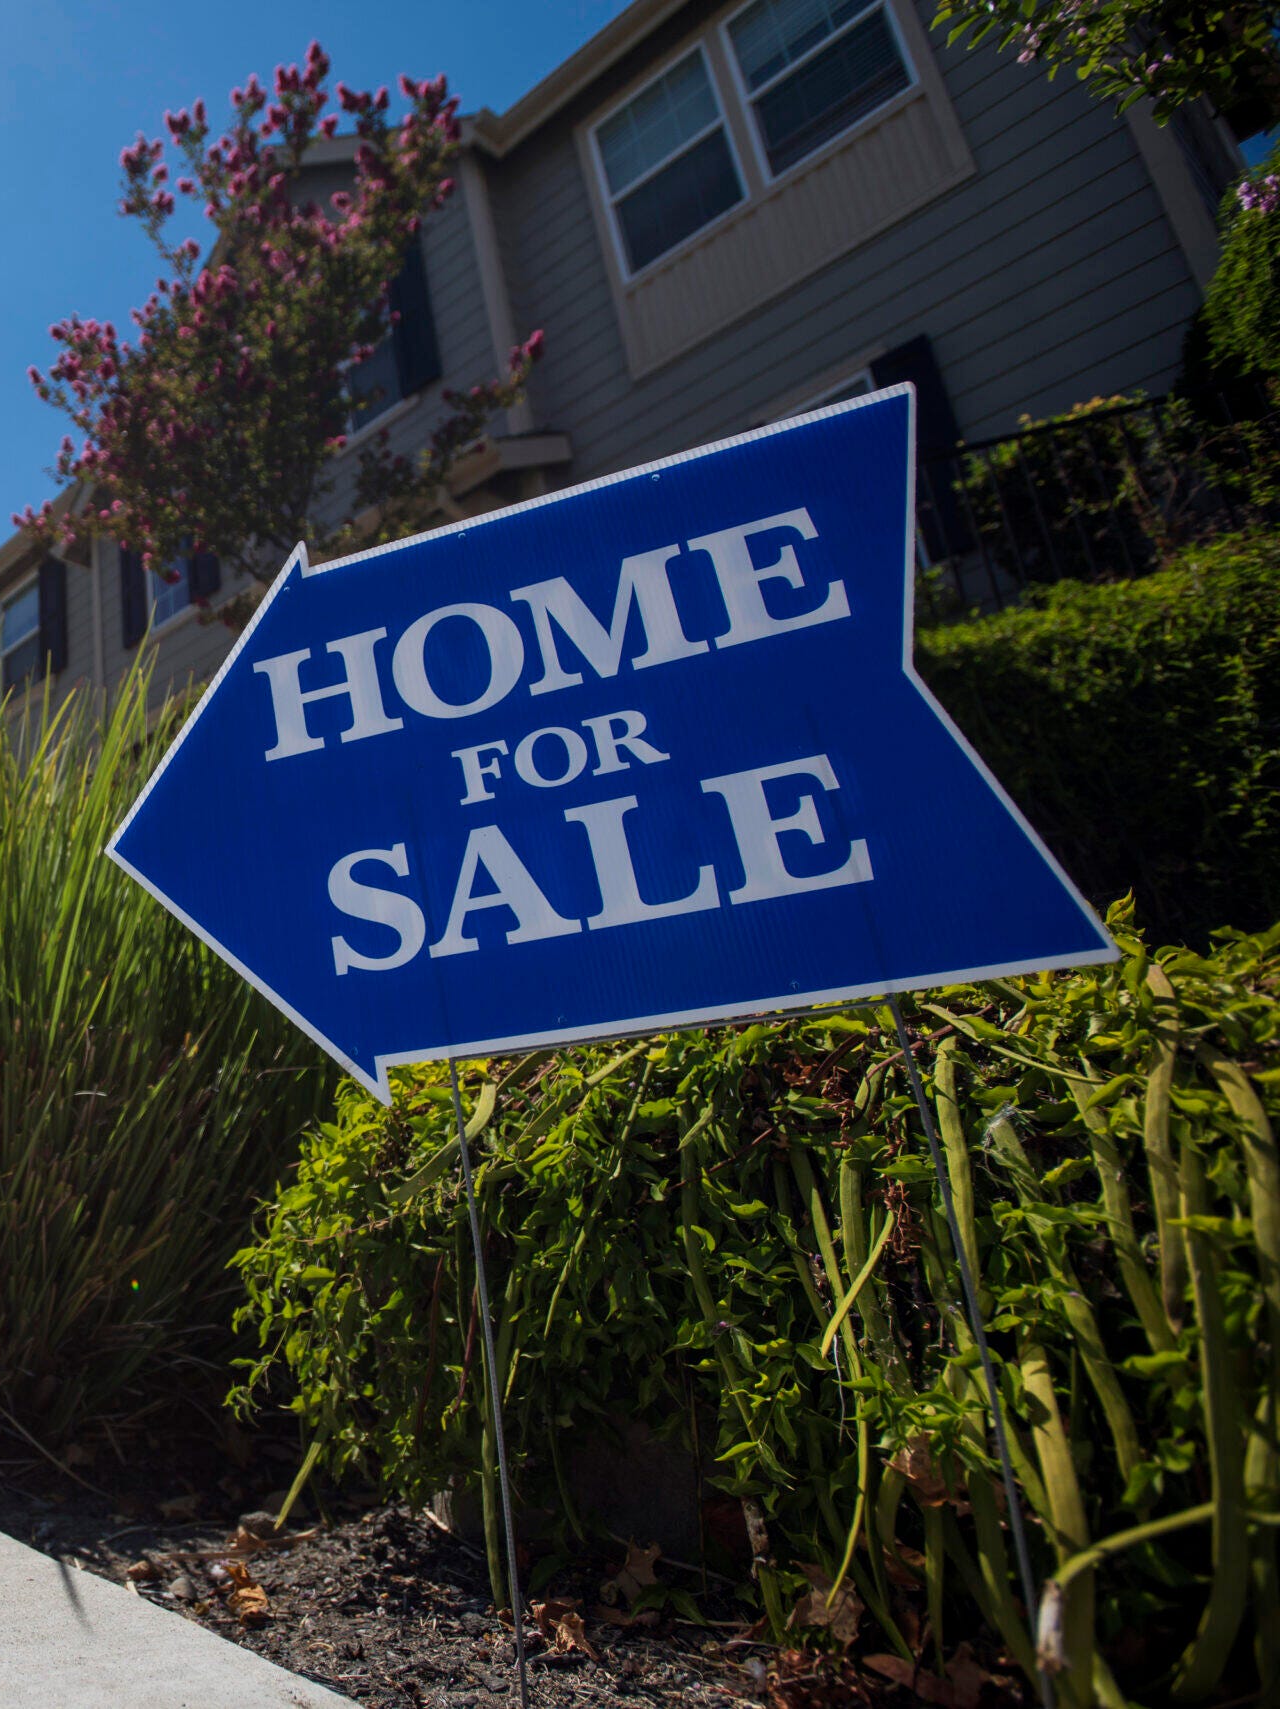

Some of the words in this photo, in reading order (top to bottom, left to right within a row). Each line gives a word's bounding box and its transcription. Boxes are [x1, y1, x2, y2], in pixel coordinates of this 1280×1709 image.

[252, 507, 851, 763] HOME
[327, 754, 875, 976] SALE
[451, 710, 670, 806] FOR
